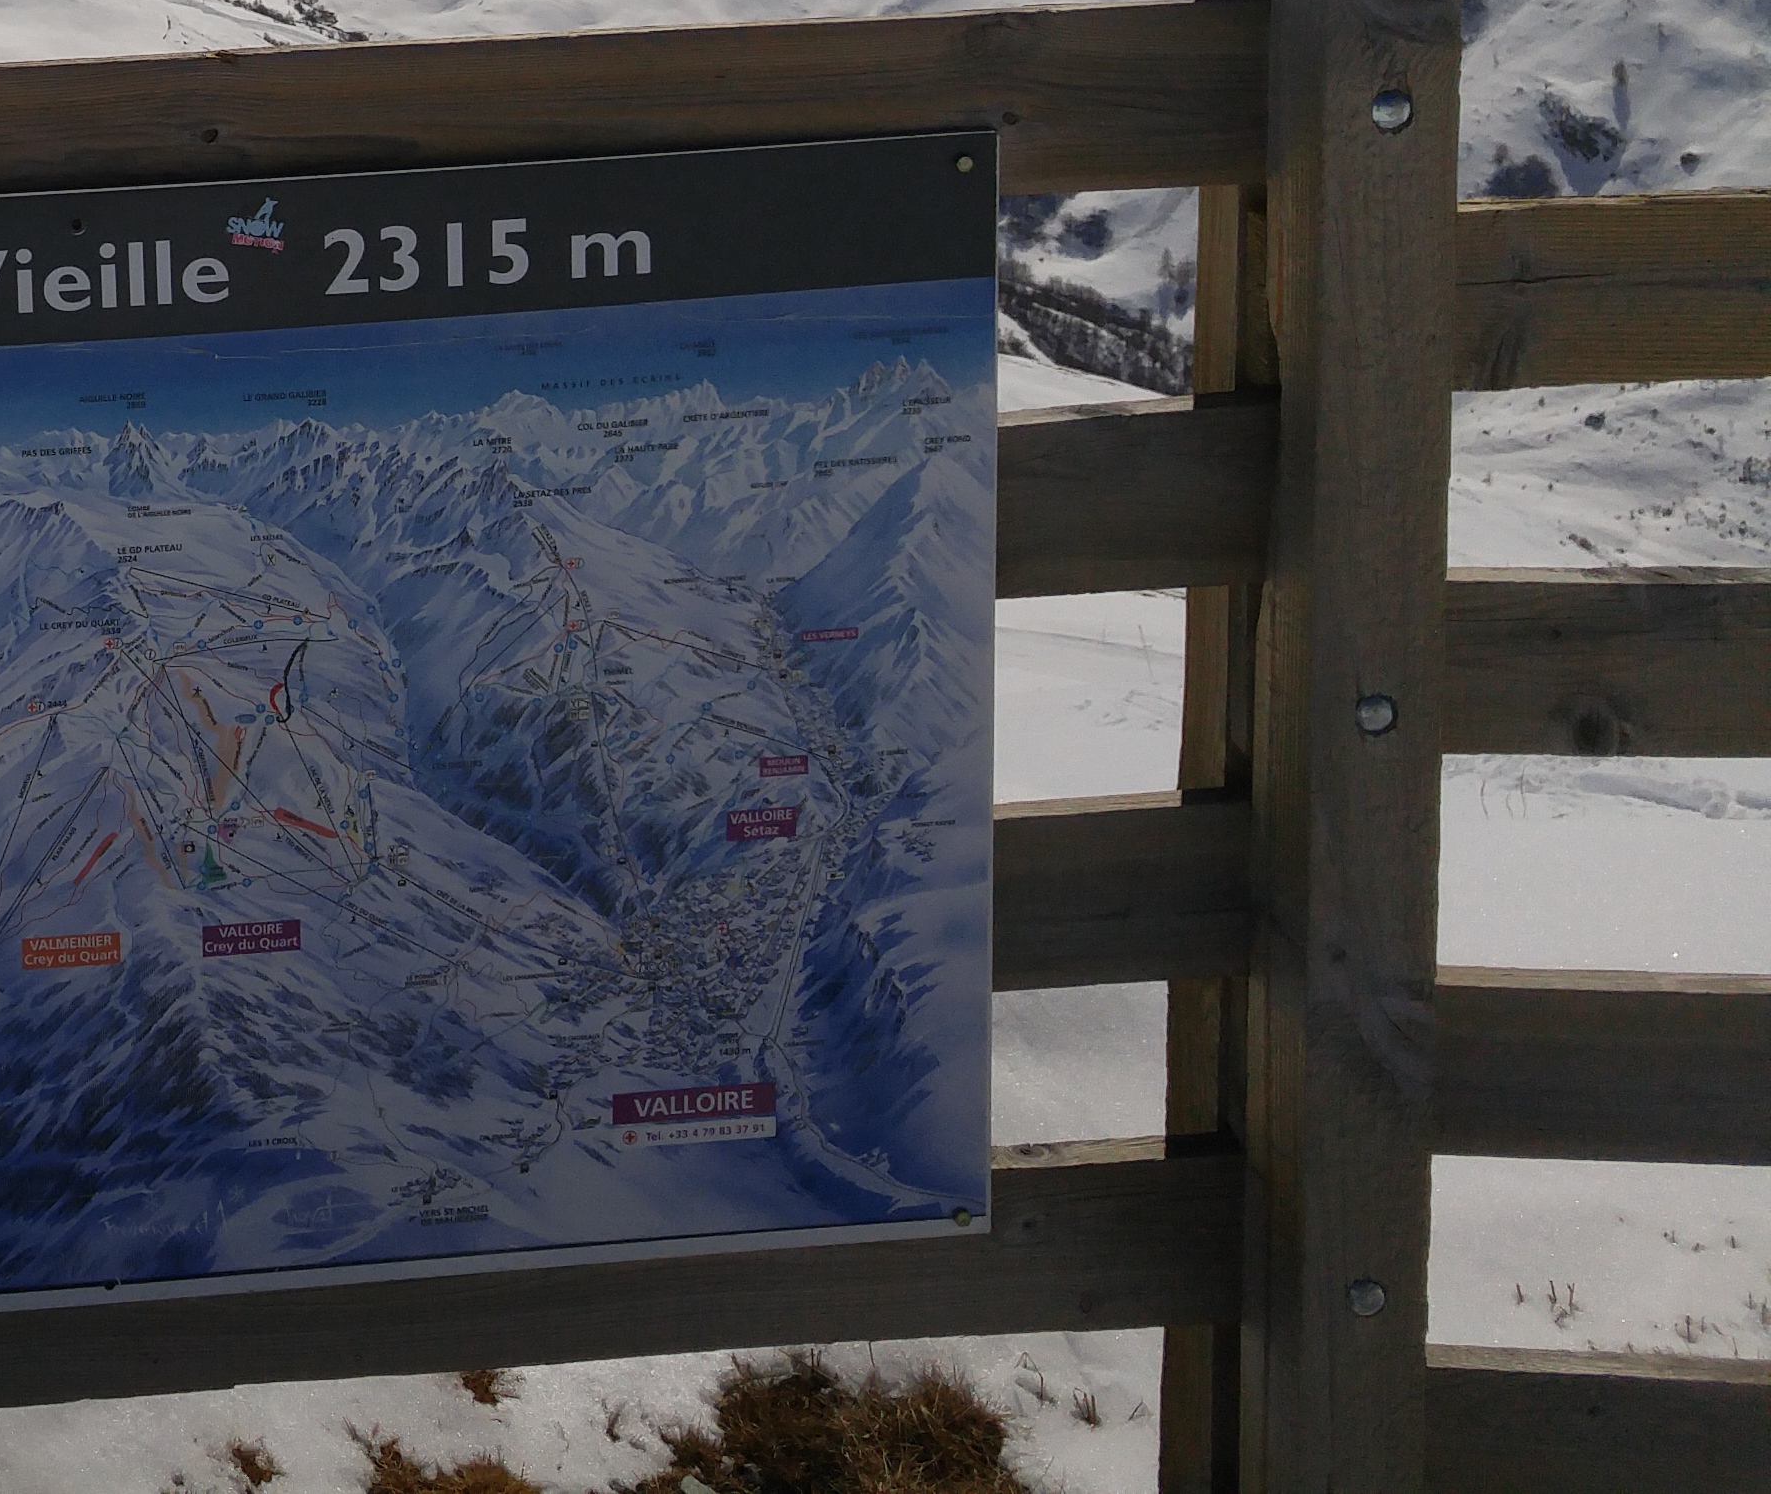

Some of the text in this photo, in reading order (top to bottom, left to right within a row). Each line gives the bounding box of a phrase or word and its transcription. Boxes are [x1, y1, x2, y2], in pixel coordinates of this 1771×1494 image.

[226, 214, 284, 239] SNOW
[324, 218, 530, 295] 2315
[570, 227, 652, 279] m
[541, 380, 592, 391] MASSIF
[601, 379, 624, 387] DES
[120, 392, 146, 401] NOIRE
[243, 393, 252, 402] LE
[255, 392, 287, 401] GRAND
[577, 423, 595, 431] COL
[473, 438, 485, 447] LA
[22, 449, 38, 458] PAS
[40, 448, 57, 457] DES
[615, 446, 626, 454] LA
[513, 490, 526, 500] LA
[526, 489, 553, 499] SETAZ
[117, 543, 183, 554] LE GD PLATEAU
[118, 554, 138, 563] 2524
[40, 618, 121, 631] LE CREY DU QUART
[730, 809, 794, 825] VALLOIRE
[743, 823, 780, 838] Sétaz
[219, 923, 283, 938] VALLOIRE
[30, 936, 112, 951] VALMEINIER
[205, 937, 299, 953] Crey du Quart
[24, 950, 119, 967] Crey du Quart
[742, 1046, 751, 1054] m
[634, 1090, 754, 1118] VALLOIRE
[646, 1132, 664, 1141] Tel.
[668, 1130, 688, 1139] +33
[692, 1129, 699, 1137] 4
[702, 1128, 715, 1137] 79
[736, 1126, 749, 1134] 37
[753, 1124, 765, 1133] 91
